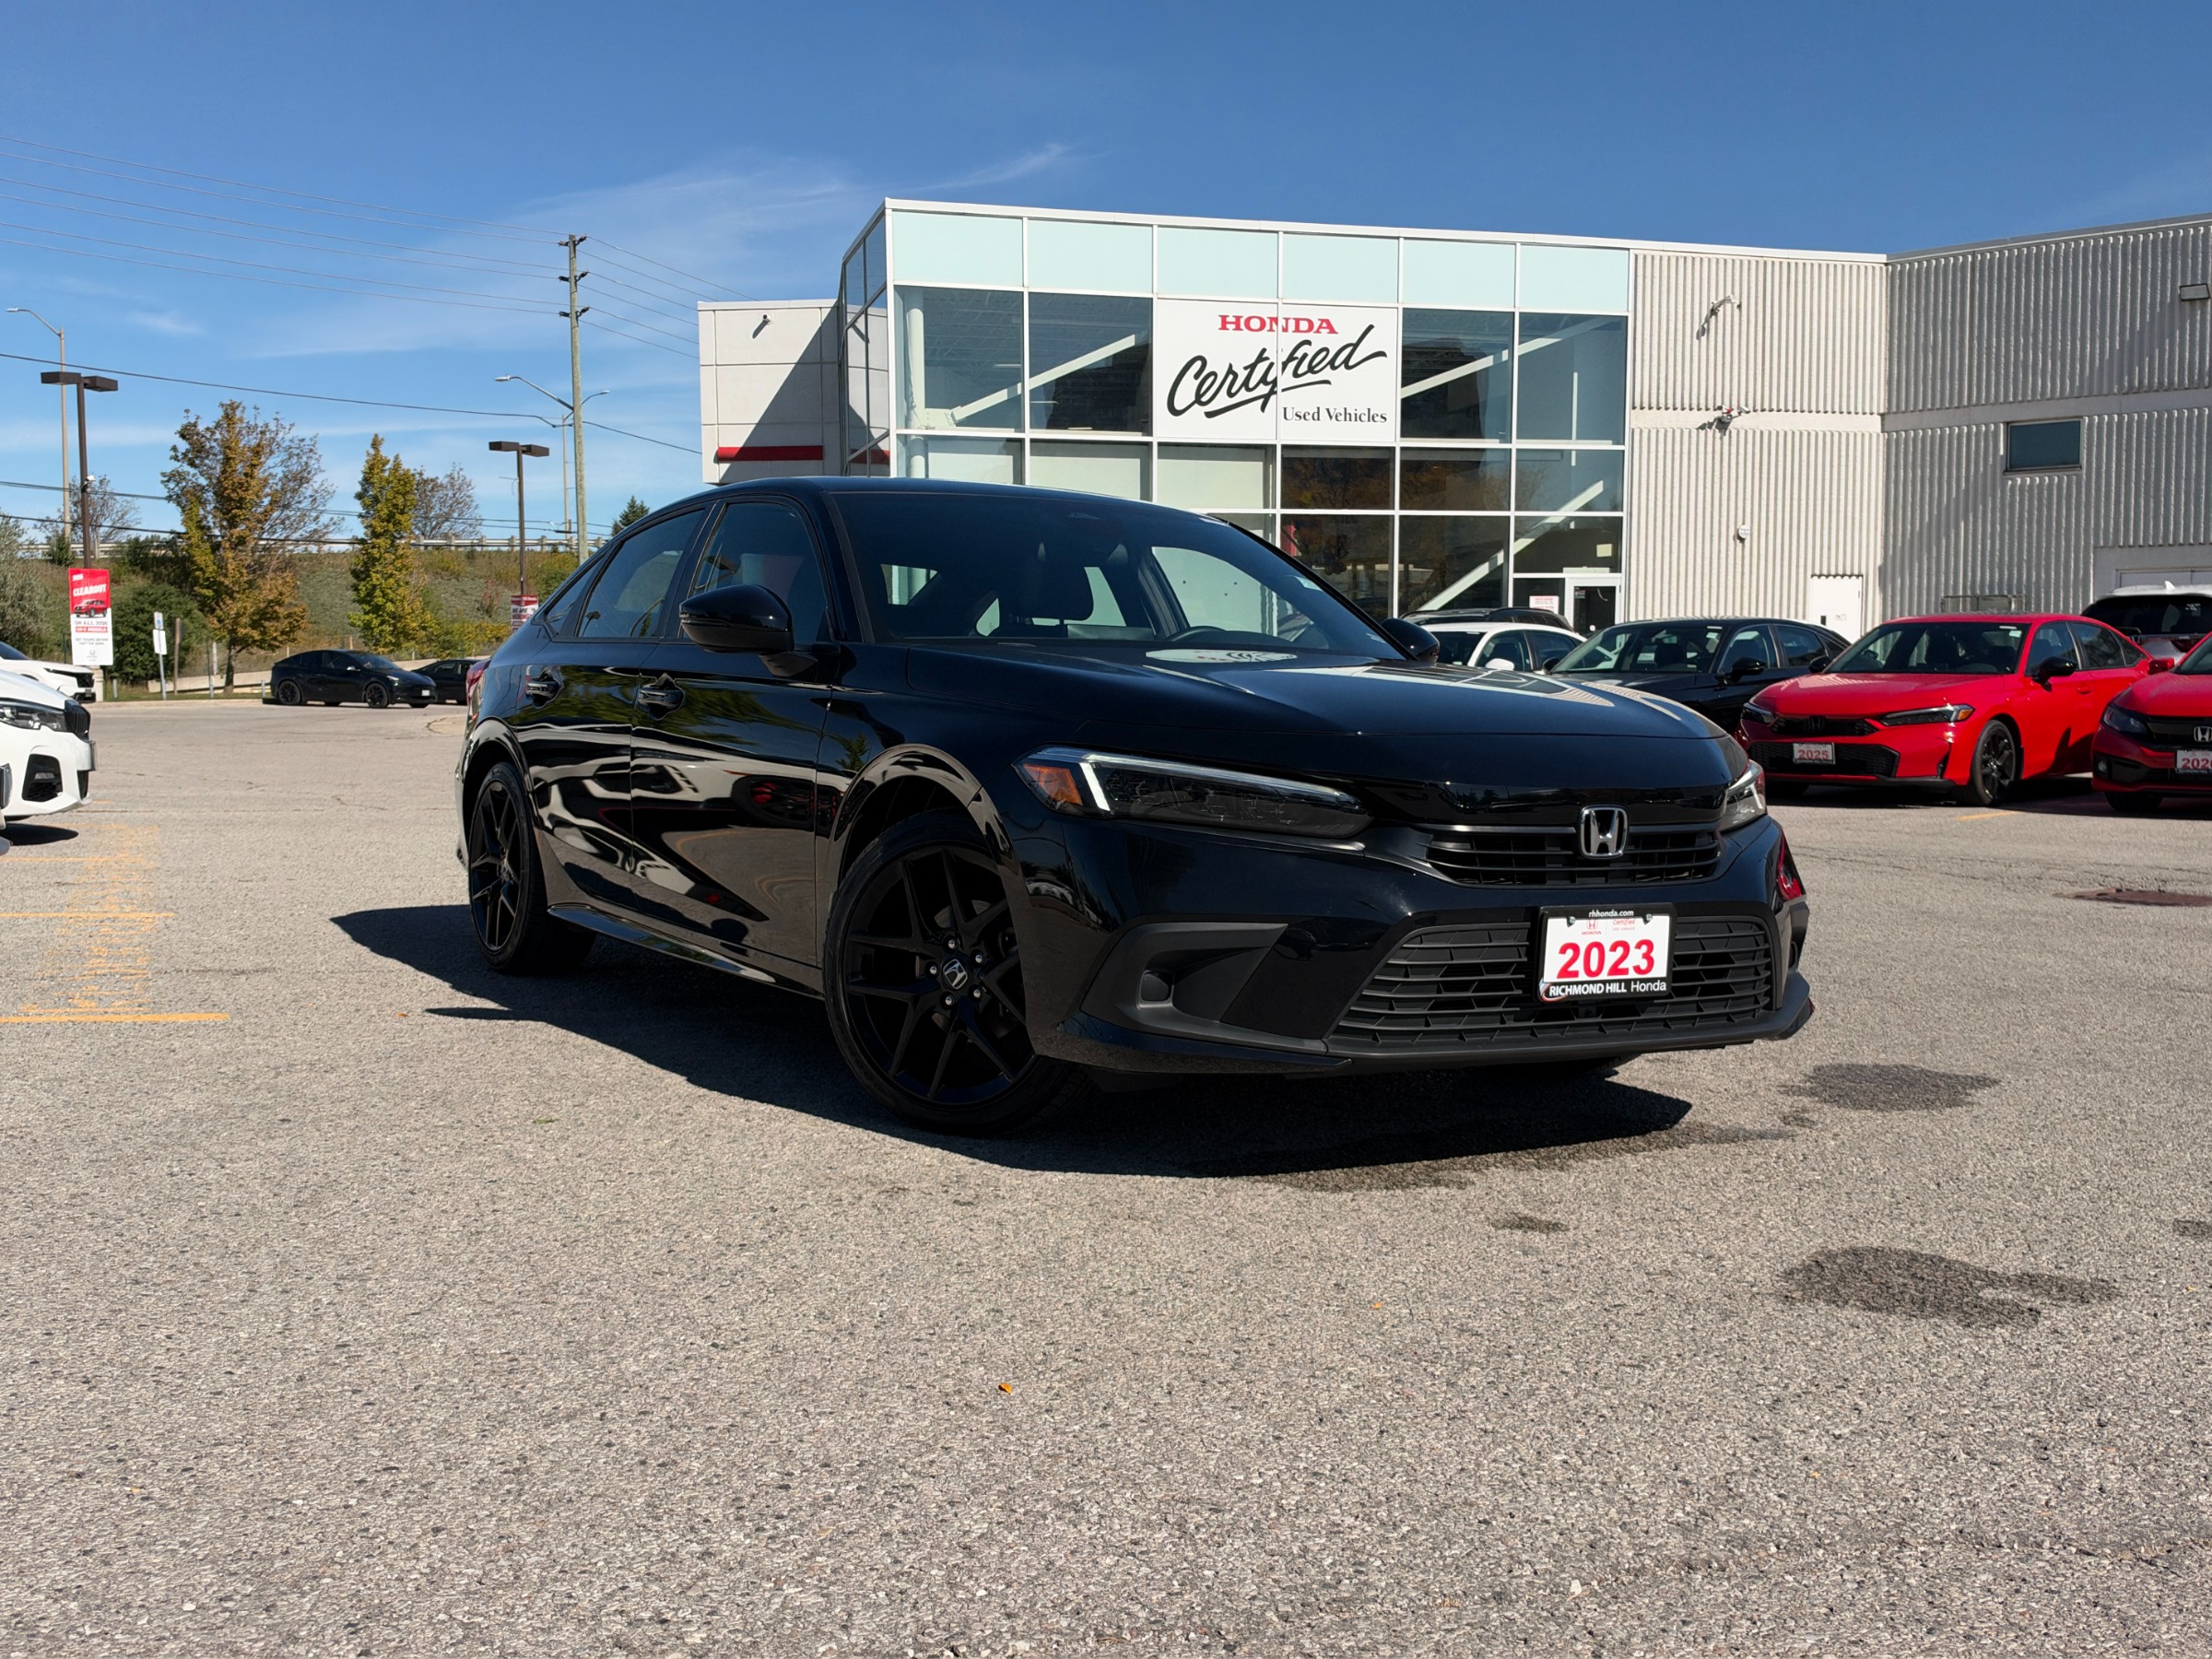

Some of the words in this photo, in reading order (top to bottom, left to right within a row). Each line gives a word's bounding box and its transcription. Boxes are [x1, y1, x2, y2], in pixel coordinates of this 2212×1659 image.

[1218, 314, 1338, 335] HONDA
[1166, 324, 1388, 418] Certified
[1282, 406, 1321, 422] Used
[1324, 407, 1388, 424] Vehicles
[73, 583, 107, 597] CLEAROUT
[1798, 749, 1829, 759] 2025
[2182, 758, 2212, 770] 202
[1588, 909, 1634, 918] rhhonda.com
[1557, 939, 1654, 979] 2023
[1548, 982, 1605, 996] RICHMOND
[1606, 982, 1627, 994] HILL
[1630, 979, 1666, 993] Honda
